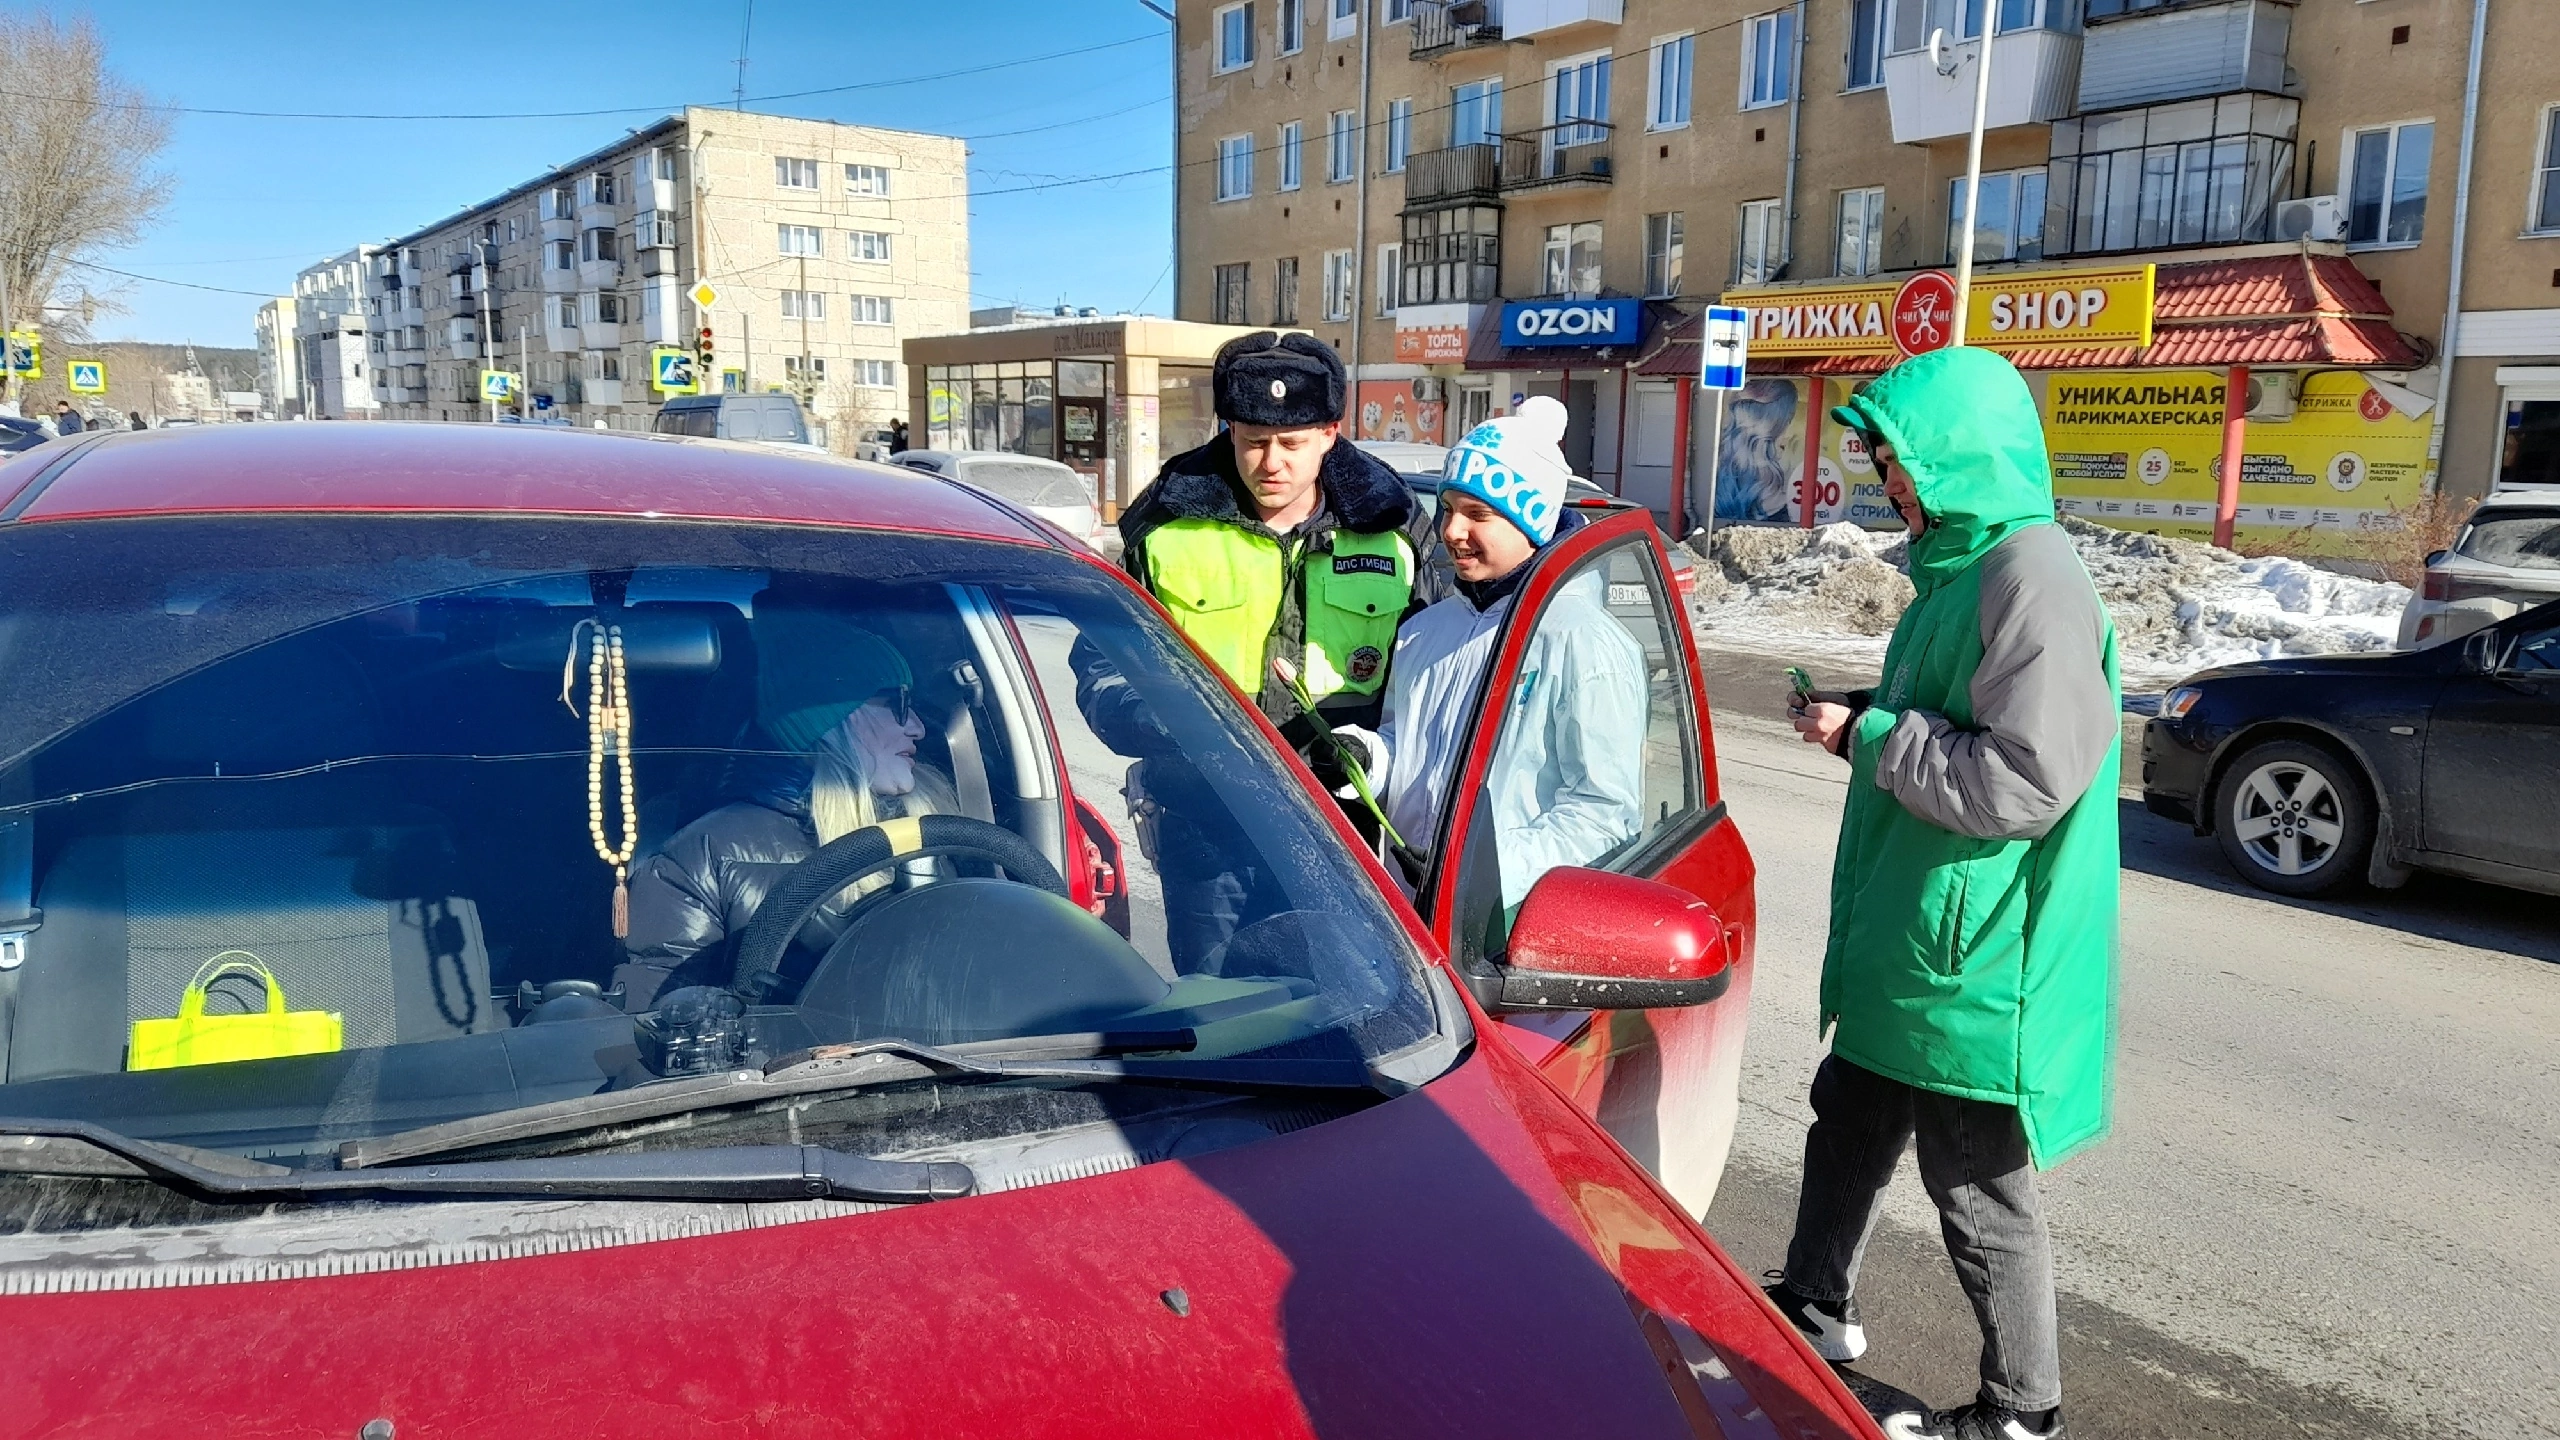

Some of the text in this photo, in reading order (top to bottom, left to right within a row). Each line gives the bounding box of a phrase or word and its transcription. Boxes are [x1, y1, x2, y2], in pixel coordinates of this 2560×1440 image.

[1902, 309, 1950, 323] ЧИК ЧИК
[1990, 288, 2108, 332] SHOP
[1517, 306, 1616, 336] OZON
[1748, 302, 1887, 340] ТРИЖКА
[1427, 333, 1461, 348] ТОРТЫ
[1424, 348, 1463, 358] ПИРОЖНЫЕ
[2058, 385, 2226, 405] УНИКАЛЬНАЯ
[2302, 398, 2352, 408] СТРИЖКА
[2056, 411, 2224, 425] ПАРИКМАХЕРСКАЯ
[2054, 453, 2110, 462] ВОЗВРАЩАЕМ
[2243, 455, 2285, 464] БЫСТРО
[2146, 460, 2162, 472] 25
[2242, 464, 2292, 475] ВЫГОДНО
[2242, 474, 2315, 484] КАЧЕСТВЕННО
[1851, 483, 1886, 497] ЛЮБ
[1851, 505, 1900, 519] СТРИЖ
[1335, 557, 1393, 573] ДПС ГИБДД
